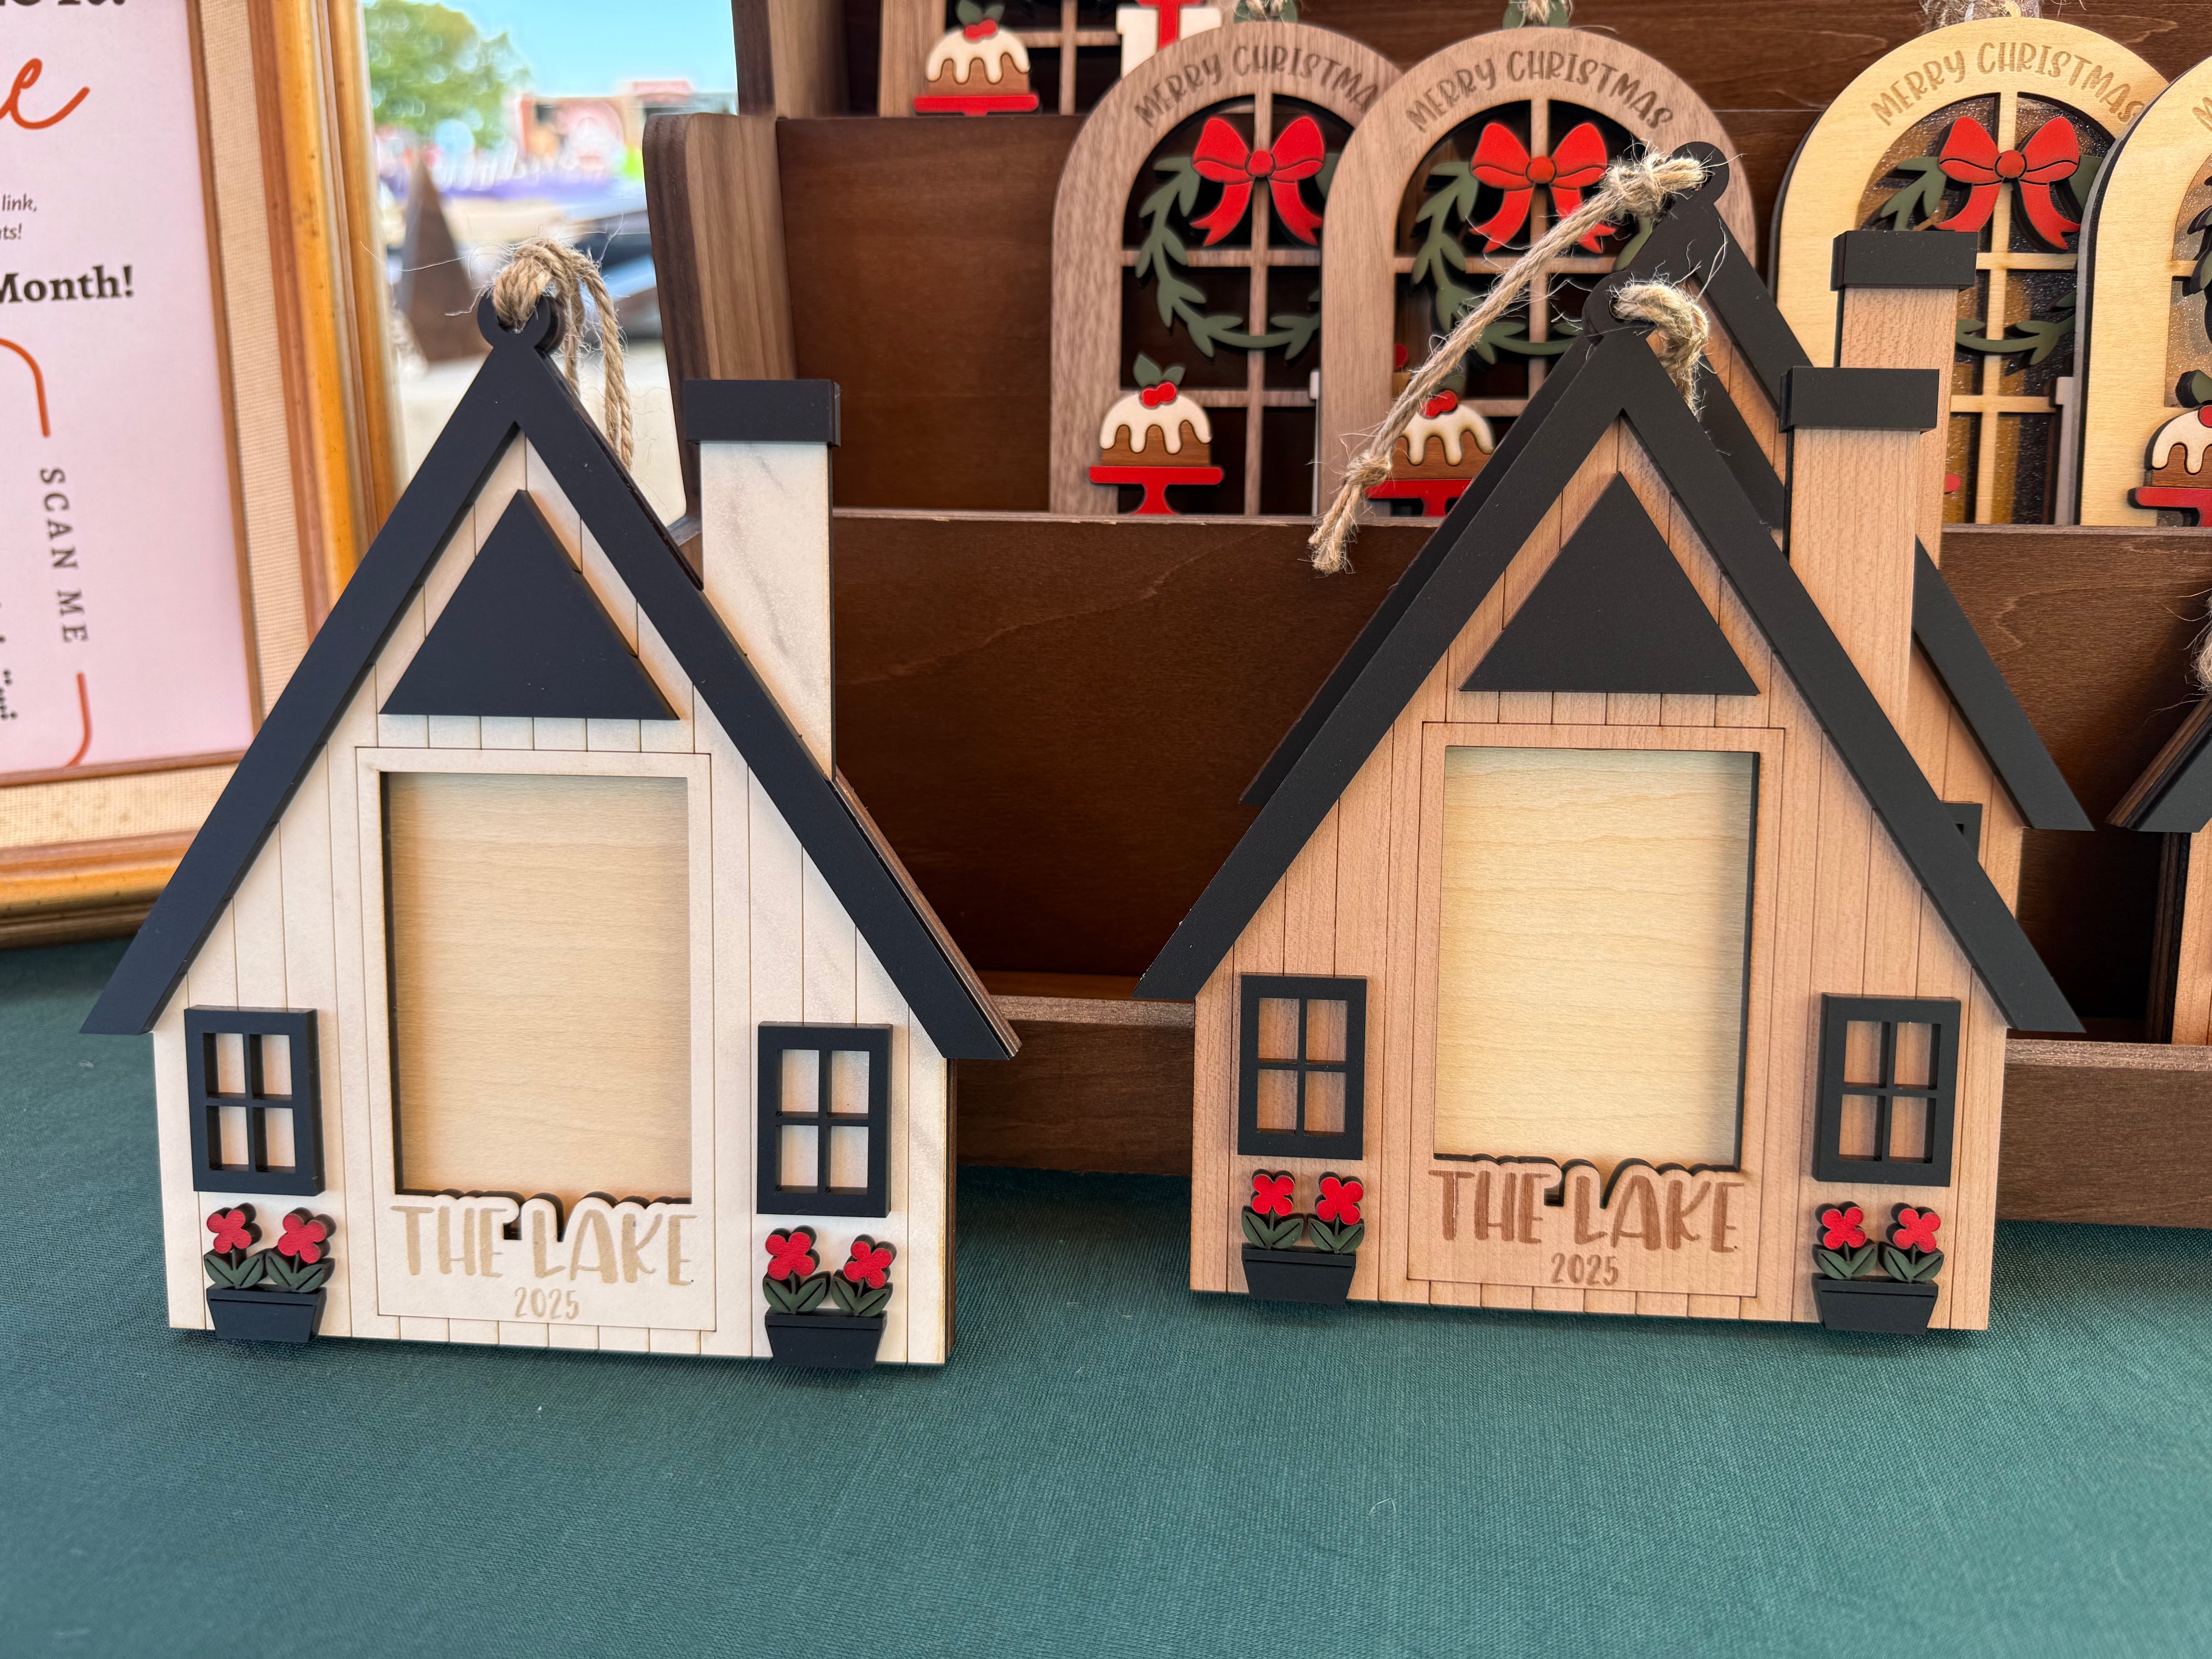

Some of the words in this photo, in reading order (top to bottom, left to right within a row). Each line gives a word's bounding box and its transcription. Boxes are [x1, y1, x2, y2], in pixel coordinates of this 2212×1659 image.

[1135, 54, 1222, 128] MERRY
[1233, 46, 1378, 115] CHRISTMA
[1406, 58, 1496, 133] MERRY
[1507, 50, 1673, 128] CHRISTMAS
[1869, 50, 1966, 127] MERRY
[1977, 41, 2145, 123] CHRISTMAS
[1, 193, 37, 213] link,
[0, 264, 134, 304] Month!
[40, 468, 78, 570] SCAN
[56, 589, 89, 643] ME
[391, 1205, 507, 1278] THE
[532, 1209, 698, 1286] LAKE
[1428, 1169, 1551, 1244] THE
[1573, 1175, 1745, 1252] LAKE
[514, 1286, 579, 1319] 2025
[1551, 1252, 1619, 1286] 2025
